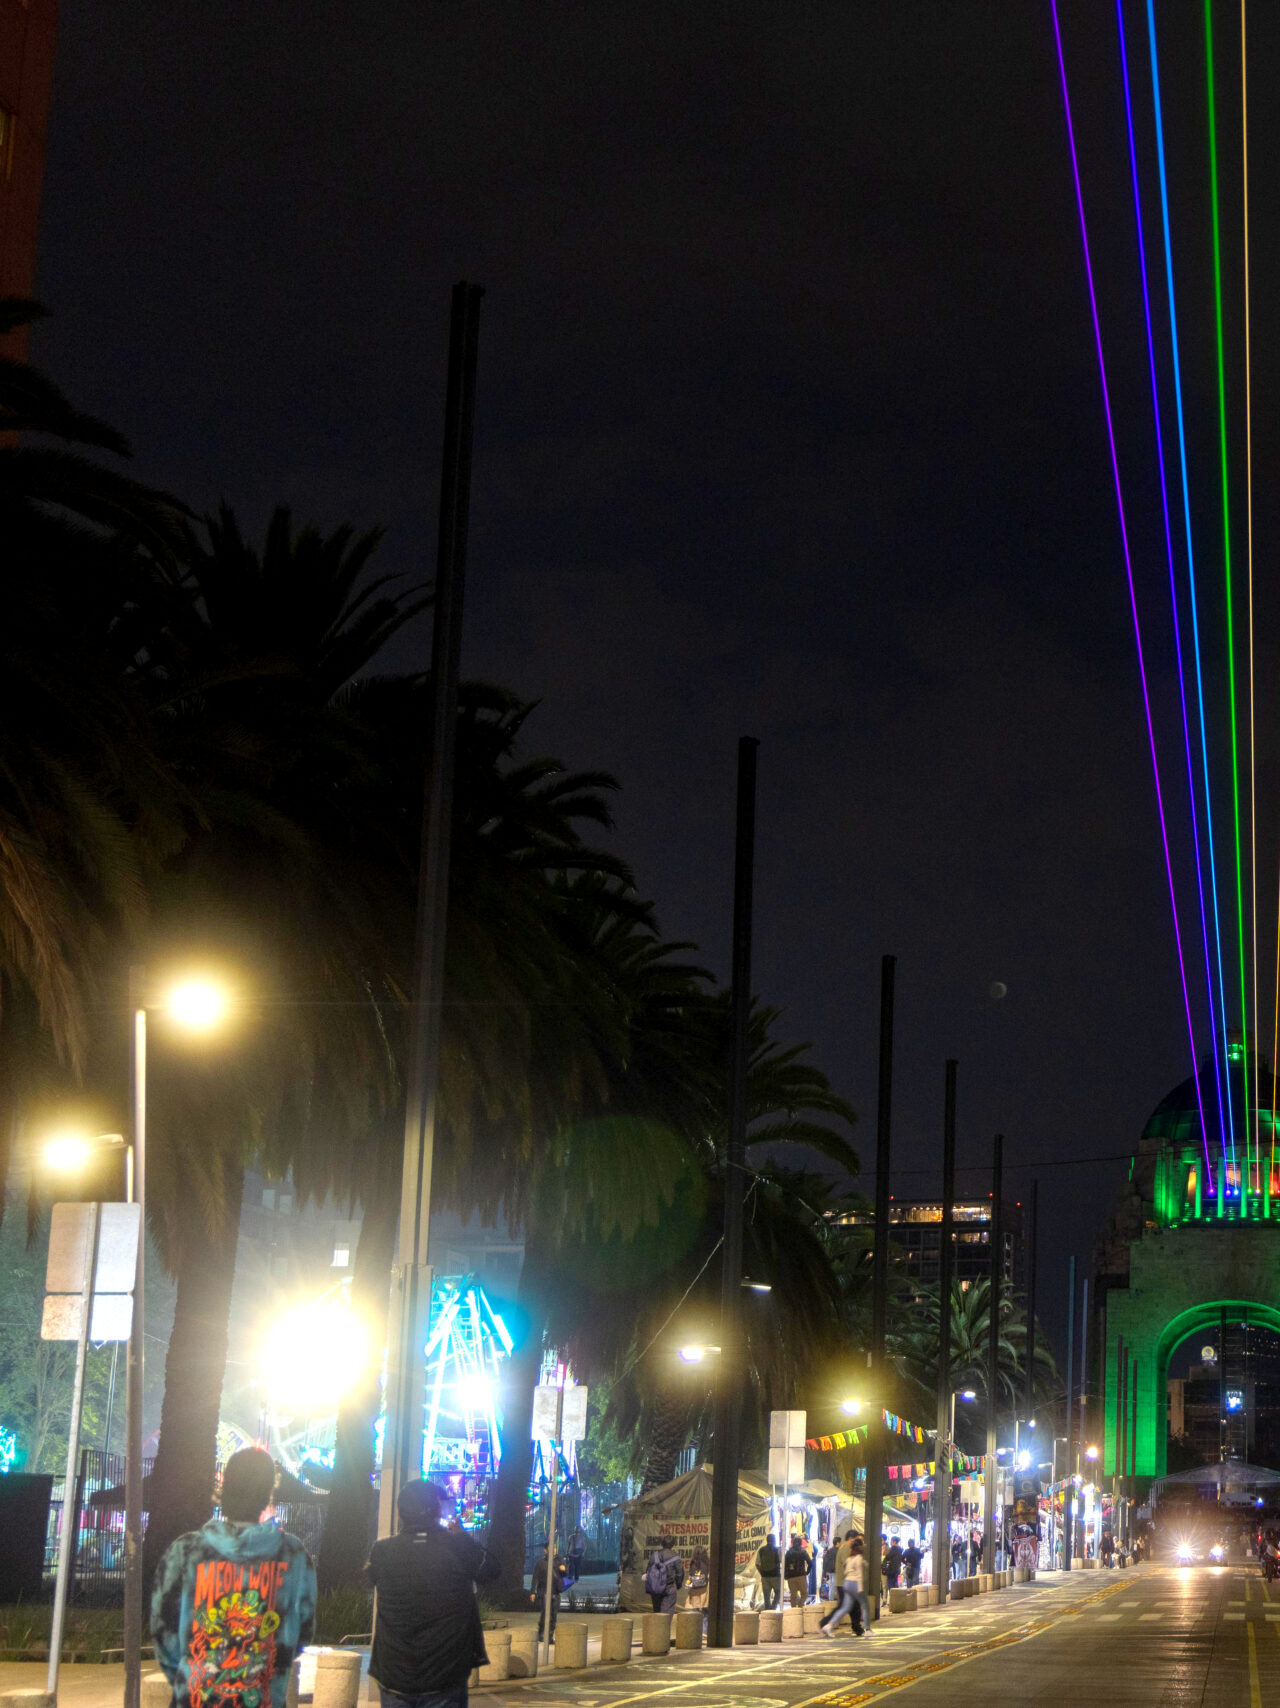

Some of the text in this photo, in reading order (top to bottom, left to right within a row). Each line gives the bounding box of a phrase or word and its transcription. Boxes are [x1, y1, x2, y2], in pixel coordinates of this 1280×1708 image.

[659, 1523, 709, 1534] ARTESANOS
[193, 1560, 288, 1613] MEOW WOLF
